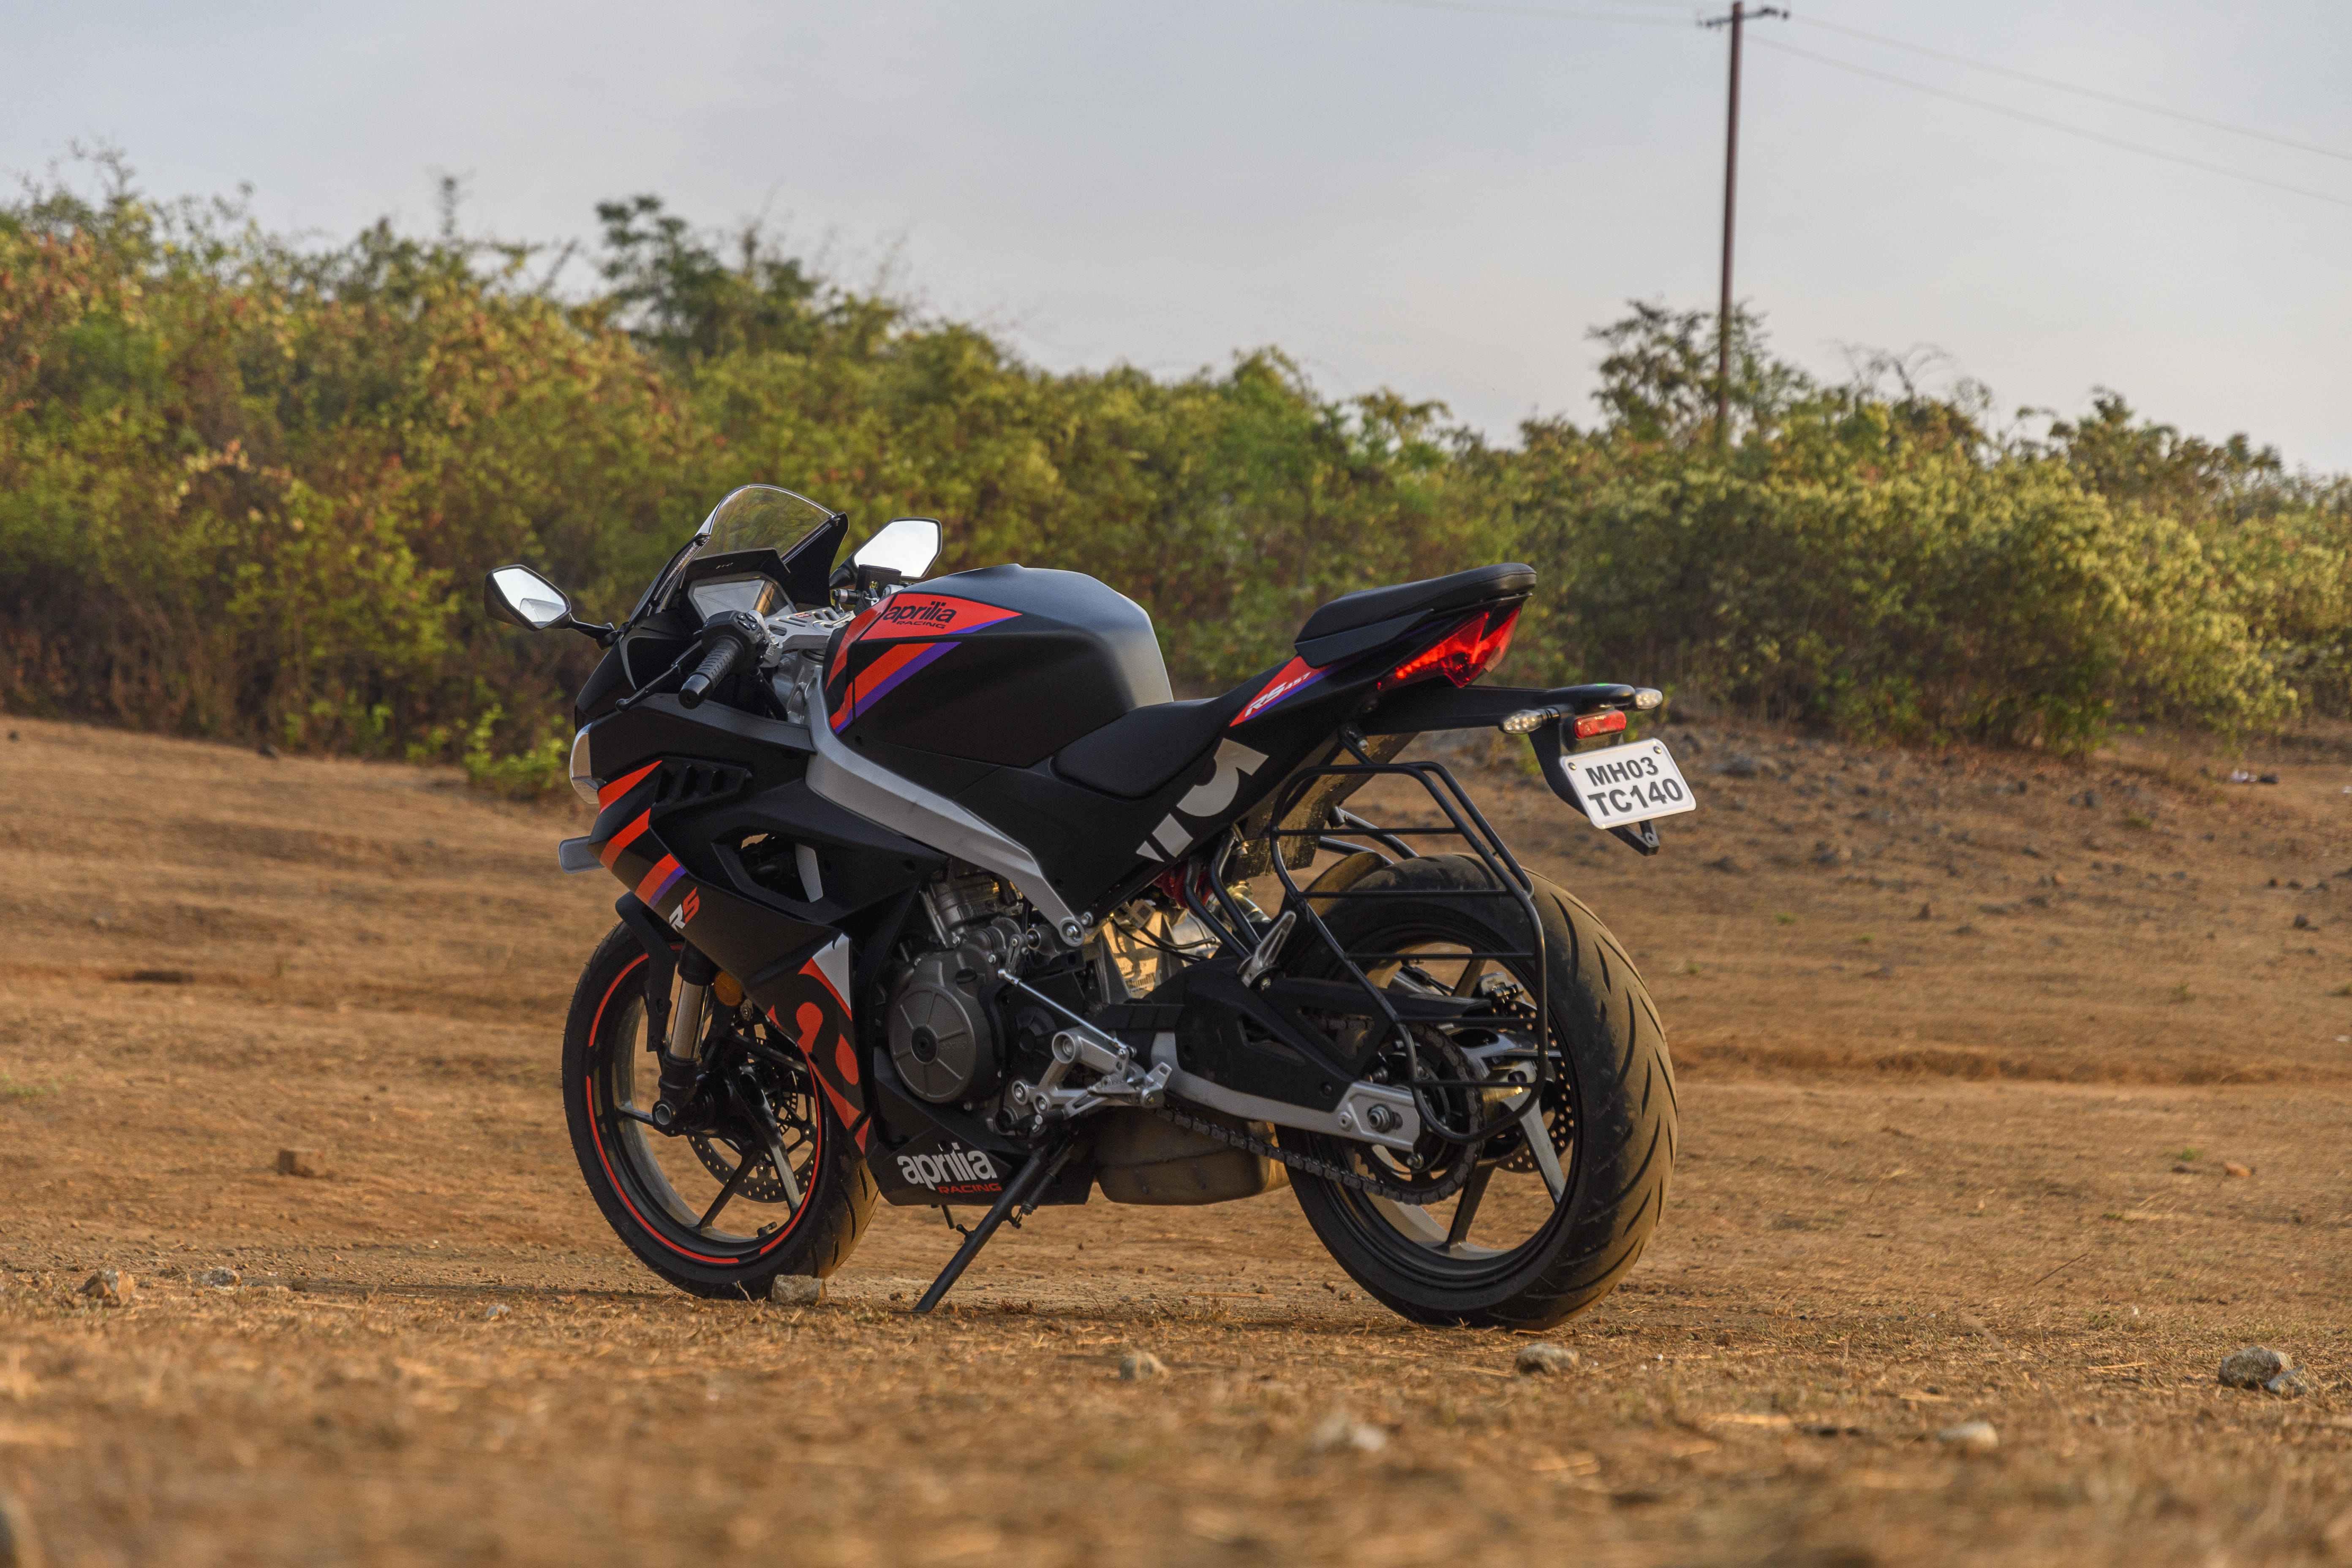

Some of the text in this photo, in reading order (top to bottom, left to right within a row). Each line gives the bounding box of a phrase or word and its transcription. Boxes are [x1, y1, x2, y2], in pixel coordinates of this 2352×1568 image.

[883, 601, 957, 623] aprilia
[896, 621, 946, 629] RACING
[1585, 757, 1658, 787] MH03
[1587, 779, 1683, 817] TC140
[669, 887, 700, 933] RS
[897, 1142, 997, 1191] aprilia
[937, 1183, 1002, 1194] RACING
